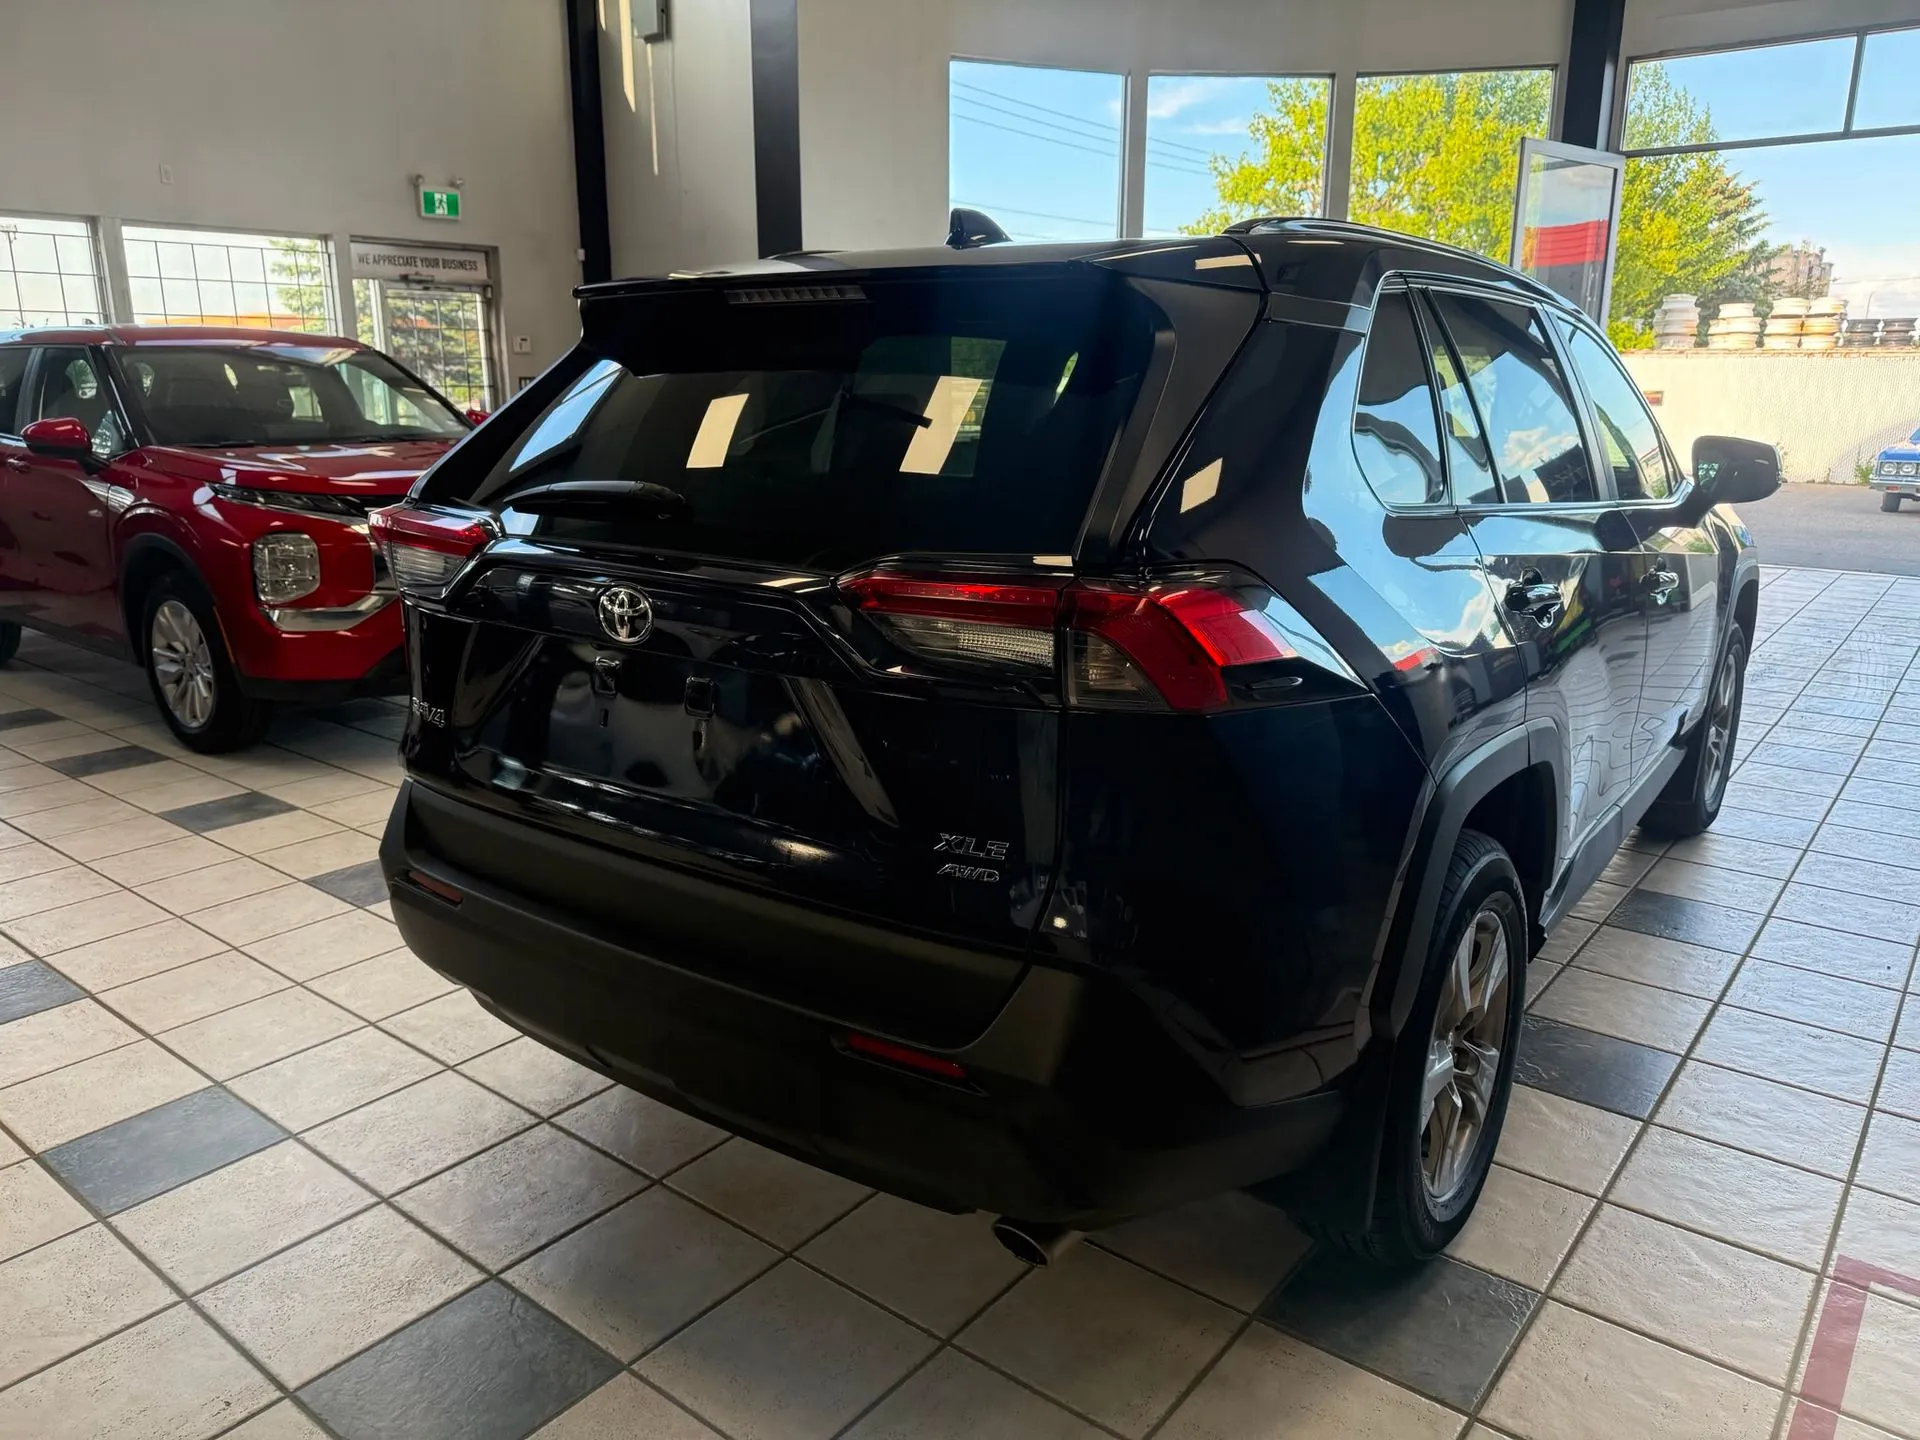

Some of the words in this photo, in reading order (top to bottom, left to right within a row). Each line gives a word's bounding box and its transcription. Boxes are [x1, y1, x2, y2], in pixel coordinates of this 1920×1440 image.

[358, 253, 370, 265] WE
[372, 254, 419, 268] APPRECIATE
[420, 256, 441, 270] YOUR
[442, 257, 478, 271] BUSINESS
[933, 832, 1010, 860] XLE
[937, 863, 1000, 882] AWD
